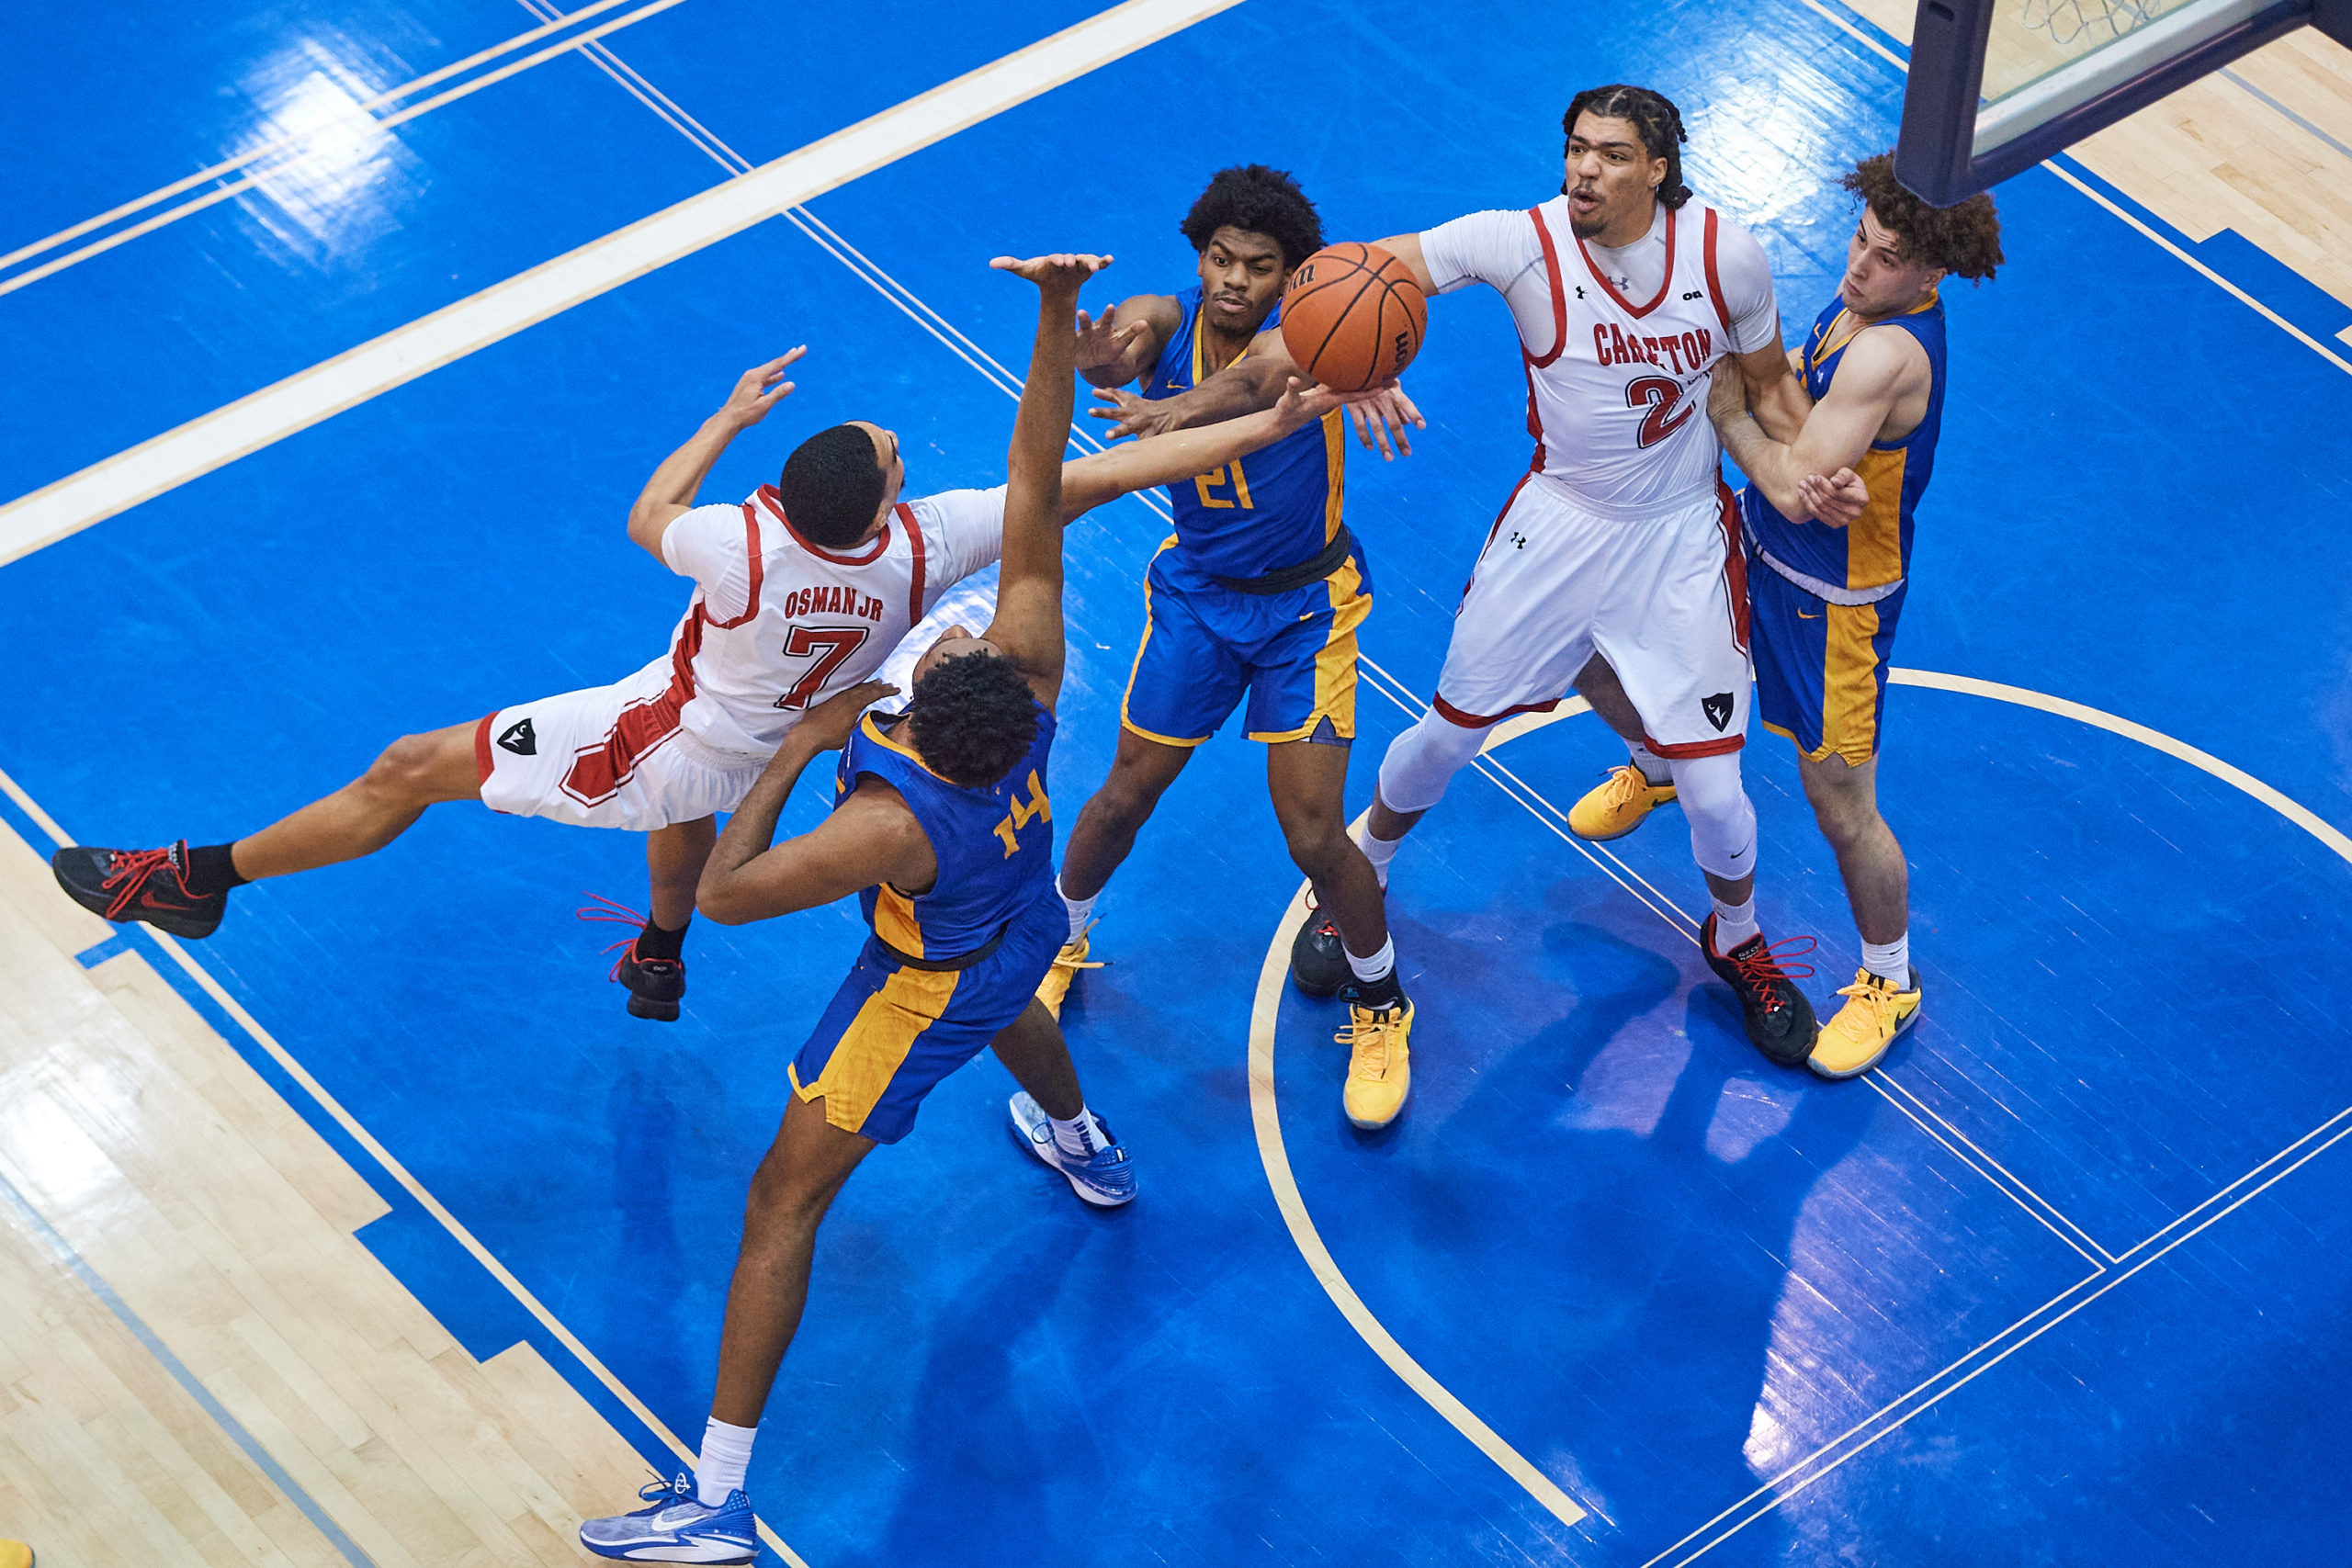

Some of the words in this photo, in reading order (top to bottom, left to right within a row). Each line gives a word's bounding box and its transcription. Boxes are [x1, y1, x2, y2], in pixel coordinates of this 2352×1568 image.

[1625, 375, 1697, 449] 2
[1194, 459, 1254, 509] 21
[785, 586, 857, 619] OSMAN
[857, 595, 884, 622] JR
[773, 625, 870, 711] 7
[993, 768, 1051, 860] 14
